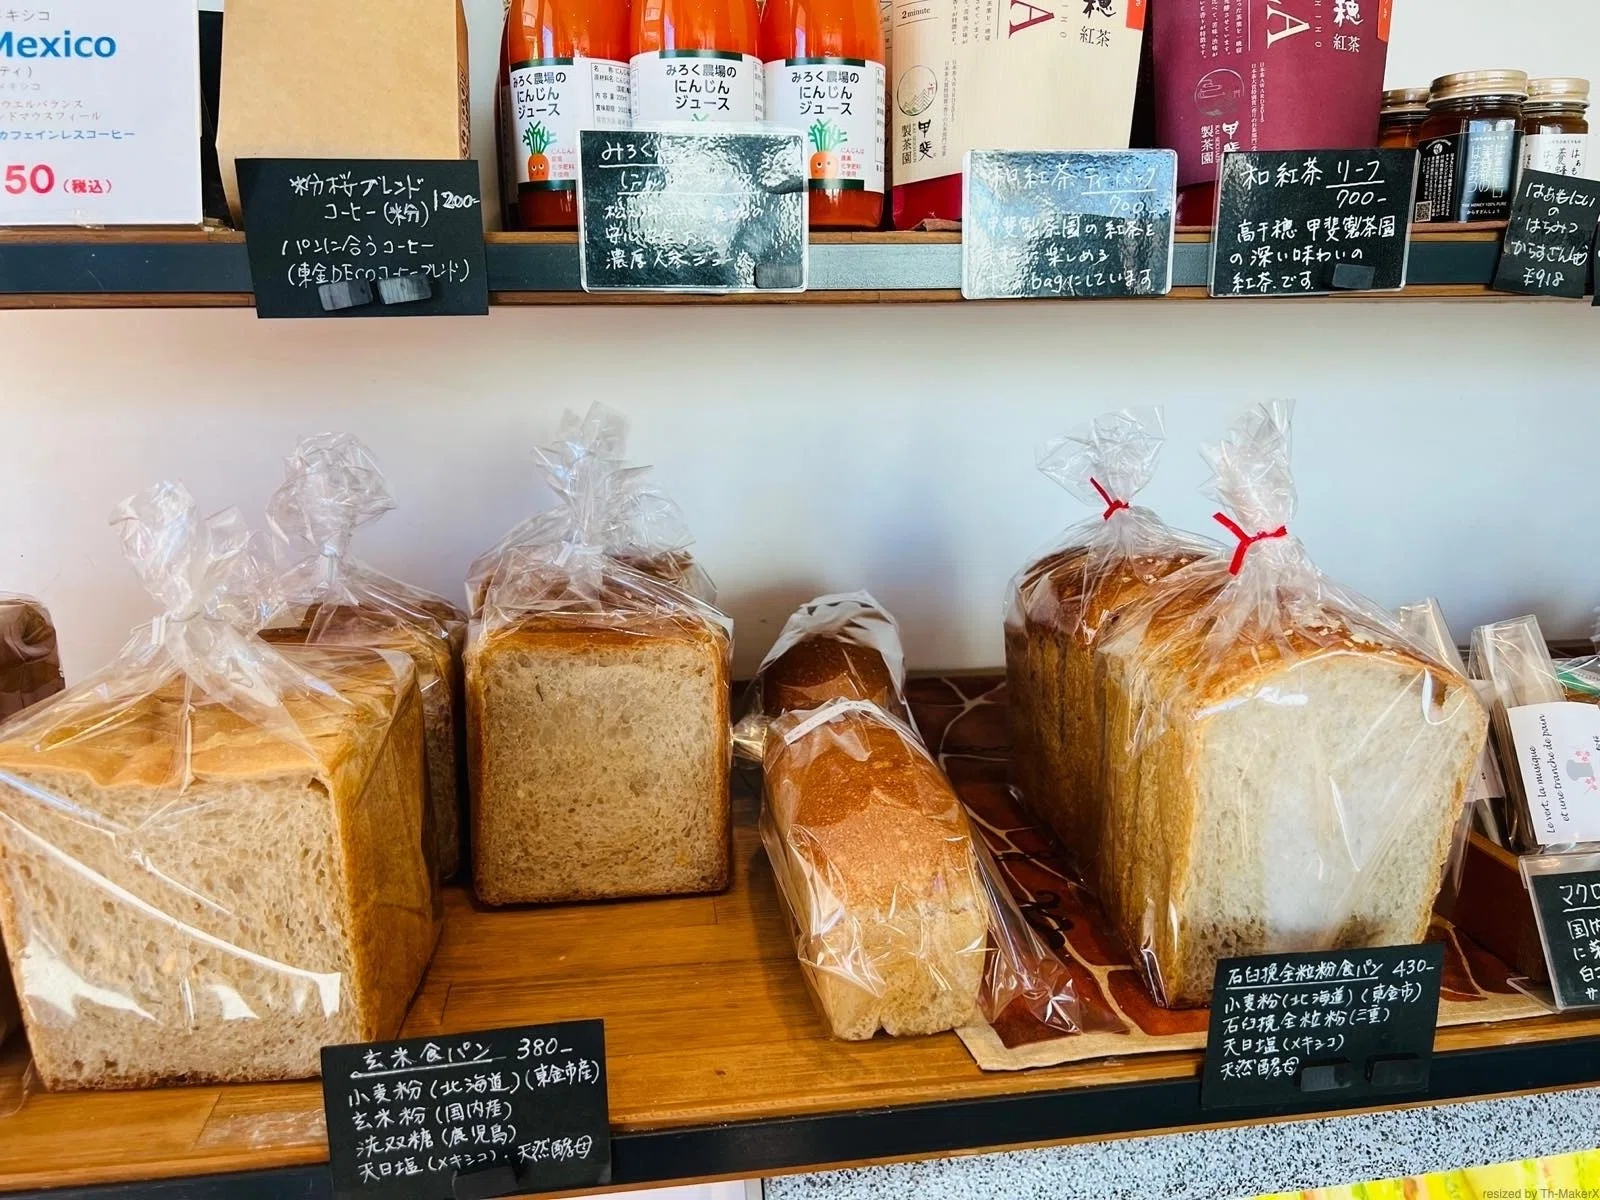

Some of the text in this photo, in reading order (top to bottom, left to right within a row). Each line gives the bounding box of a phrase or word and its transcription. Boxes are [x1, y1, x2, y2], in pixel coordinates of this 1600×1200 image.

[0, 9, 50, 22] キシコ
[1266, 0, 1311, 49] A
[1080, 25, 1111, 47] 紅茶
[1333, 33, 1360, 52] 紅茶
[666, 64, 737, 77] みろく農場の
[792, 70, 860, 83] みろく農場の
[513, 72, 567, 88] みろく農場の
[675, 79, 730, 95] にんじん
[517, 87, 560, 104] にんじん
[799, 85, 852, 100] にんじん
[518, 103, 560, 119] ジュース
[675, 95, 730, 111] ジュース
[799, 101, 852, 115] ジュース
[0, 112, 101, 122] ドマウスフィール
[0, 130, 135, 140] カフェインレスコーヒー
[901, 123, 913, 166] 製茶園
[1201, 124, 1214, 165] 製茶園
[1337, 159, 1380, 182] リーフ
[63, 179, 112, 193] (税込)
[1336, 189, 1387, 209] 700-
[1548, 206, 1560, 216] の
[1237, 215, 1395, 244] 高千穂 甲斐製茶園
[1525, 217, 1579, 236] はちみつ
[1229, 245, 1363, 268] の深い味わいの
[1227, 958, 1436, 986] 石臼挽全粒粉食パン 430-
[1579, 965, 1600, 984] 白
[516, 1037, 573, 1060] 380-
[1220, 1055, 1300, 1081] 天然酵母
